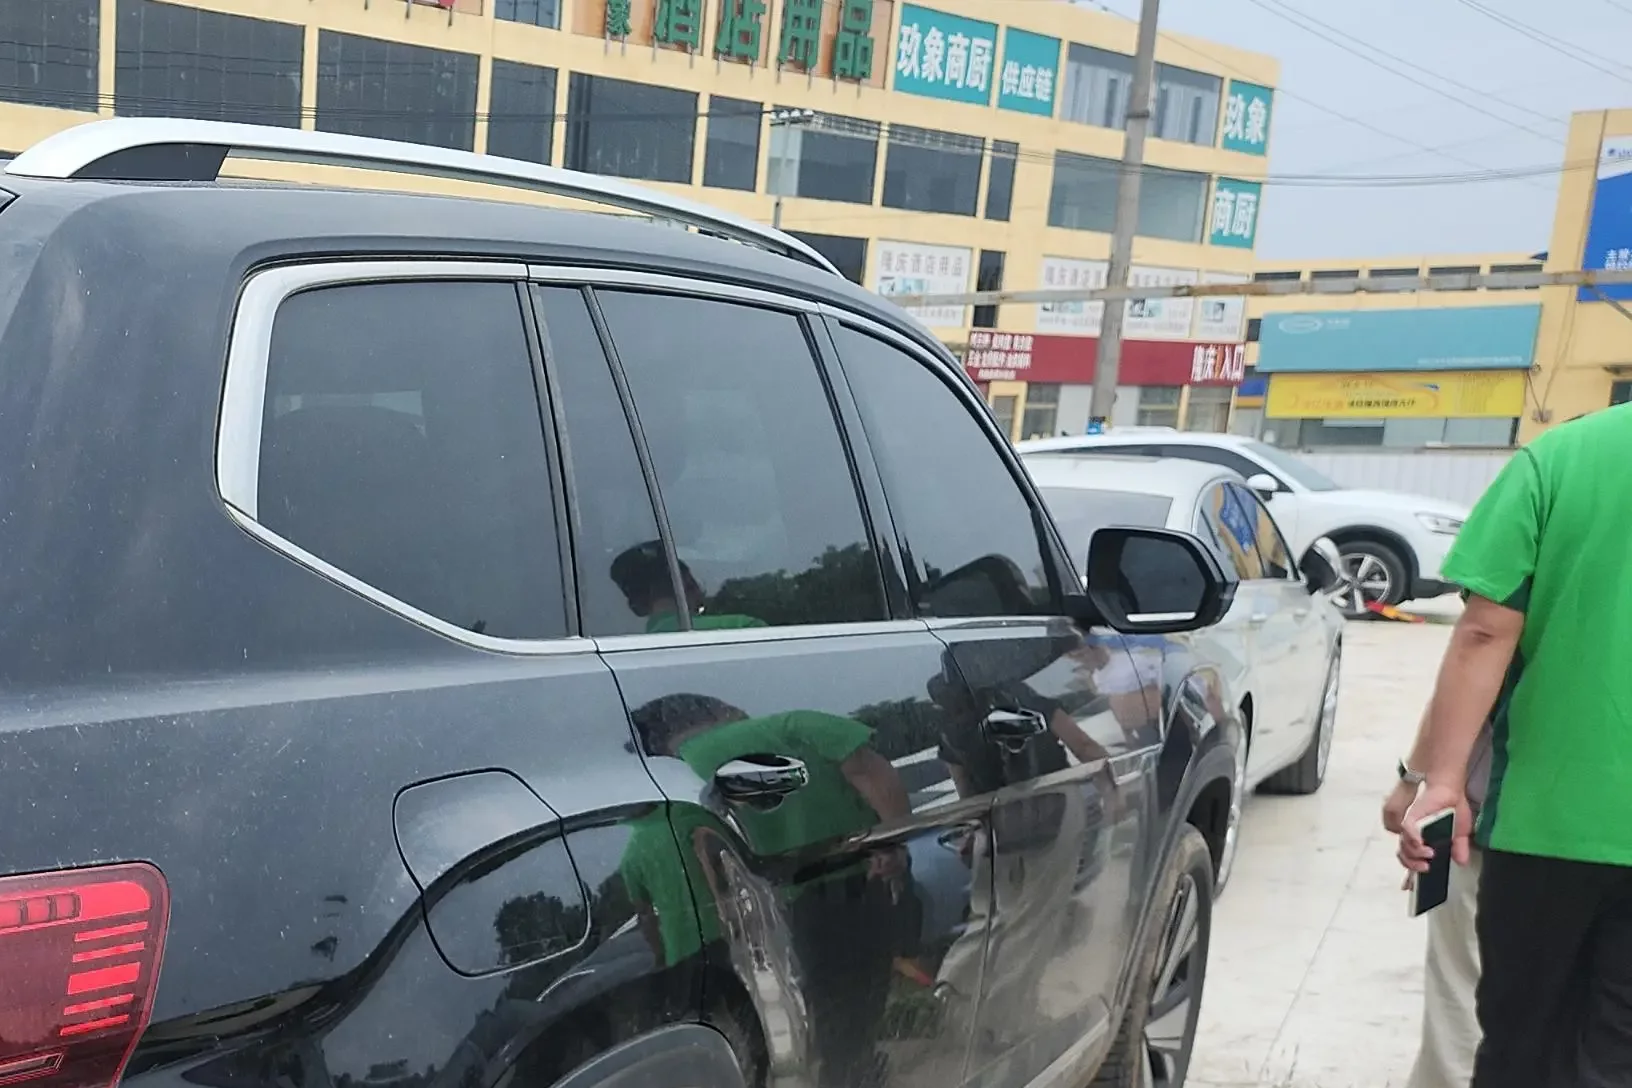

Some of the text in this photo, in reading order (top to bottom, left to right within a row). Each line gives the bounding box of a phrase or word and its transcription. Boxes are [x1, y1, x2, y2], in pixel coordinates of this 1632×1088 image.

[897, 23, 993, 93] 玖象商厨
[1001, 60, 1053, 103] 供应链
[1223, 96, 1266, 144] 玖象
[1212, 188, 1257, 239] 商厨
